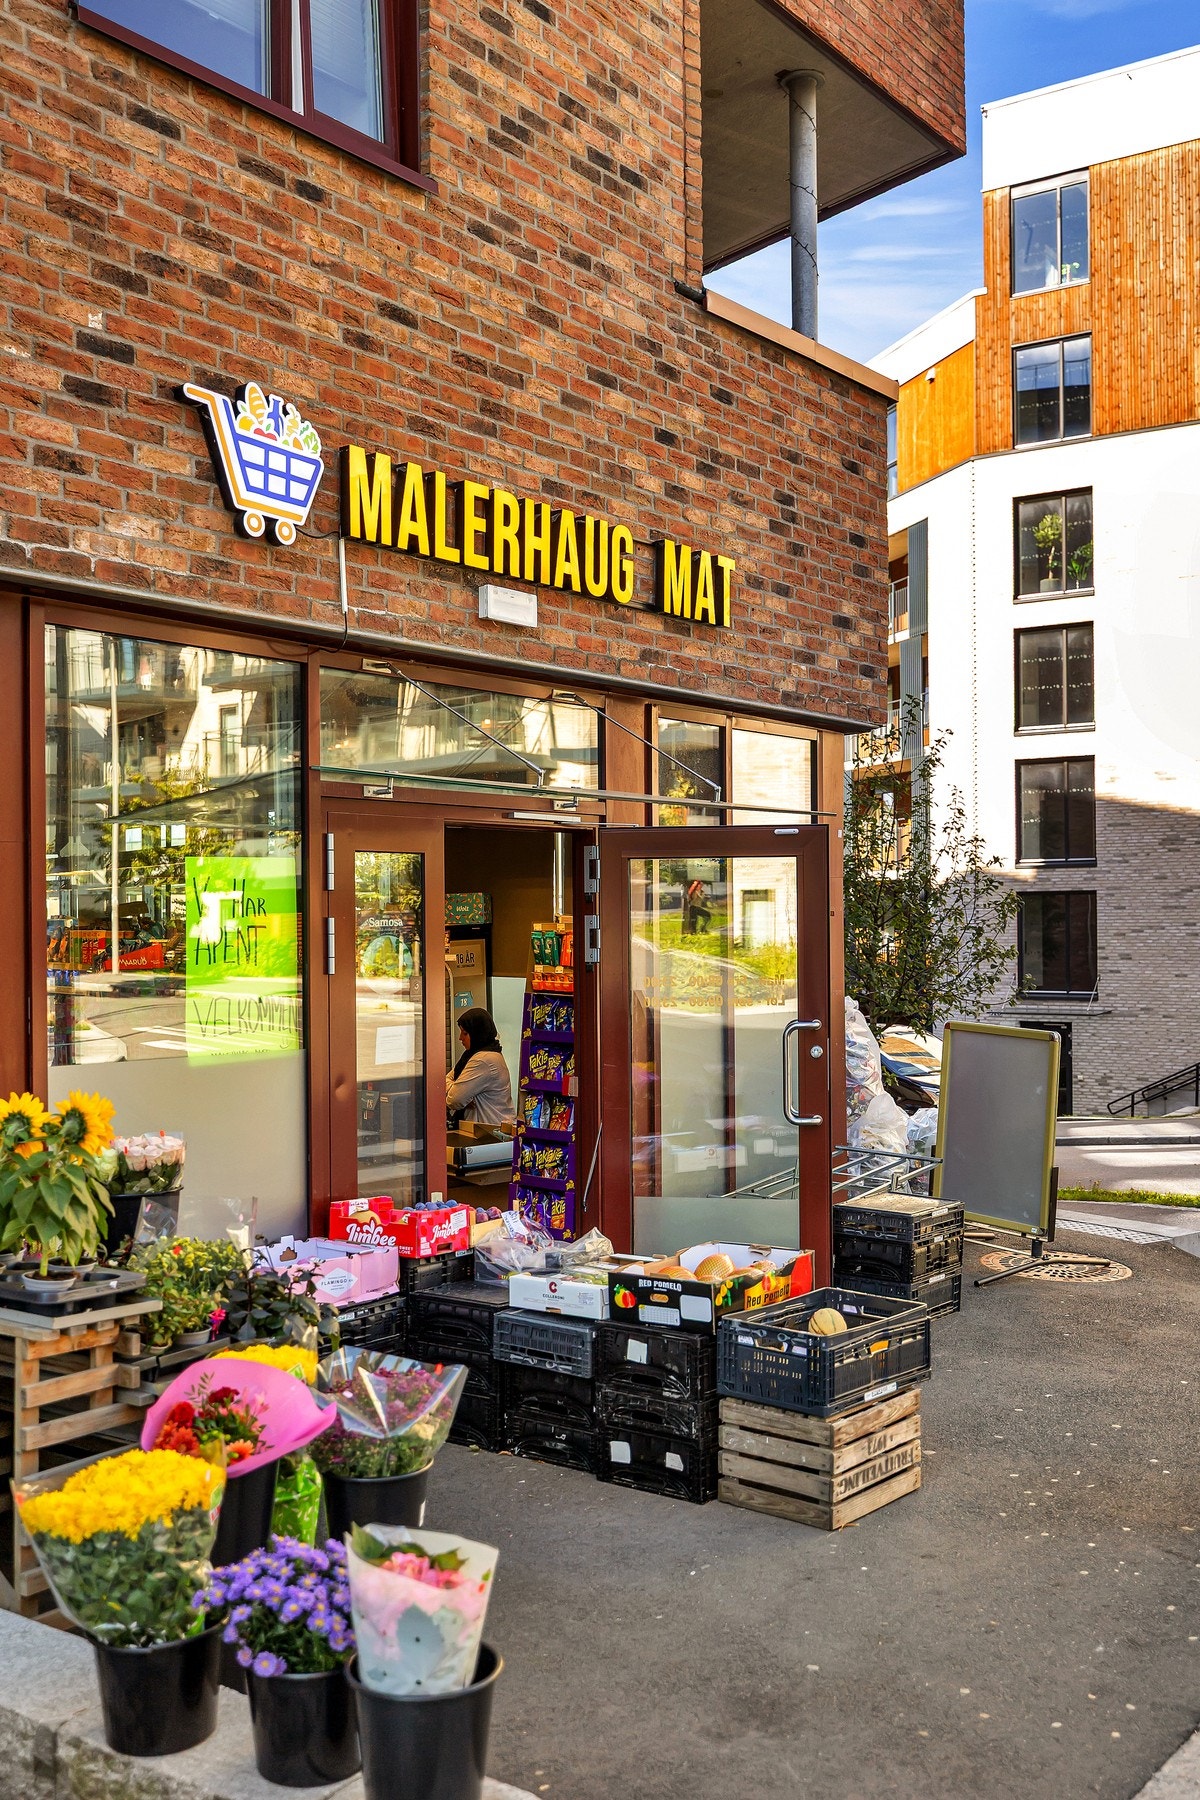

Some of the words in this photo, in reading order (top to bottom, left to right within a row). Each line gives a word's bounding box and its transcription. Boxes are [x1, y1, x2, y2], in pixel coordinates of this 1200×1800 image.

[348, 446, 634, 604] MALERHAUG
[662, 540, 737, 628] MAT
[368, 917, 404, 928] Samosa
[456, 953, 464, 964] 18
[193, 994, 299, 1037] VELKOMMEN
[529, 1053, 549, 1071] Takis
[524, 1098, 539, 1111] akis
[551, 1200, 566, 1215] akis
[321, 1278, 348, 1286] FLAMINGO
[638, 1278, 652, 1287] RED
[653, 1280, 682, 1292] POMELO
[747, 1295, 762, 1308] Red
[763, 1283, 790, 1303] Pomelo
